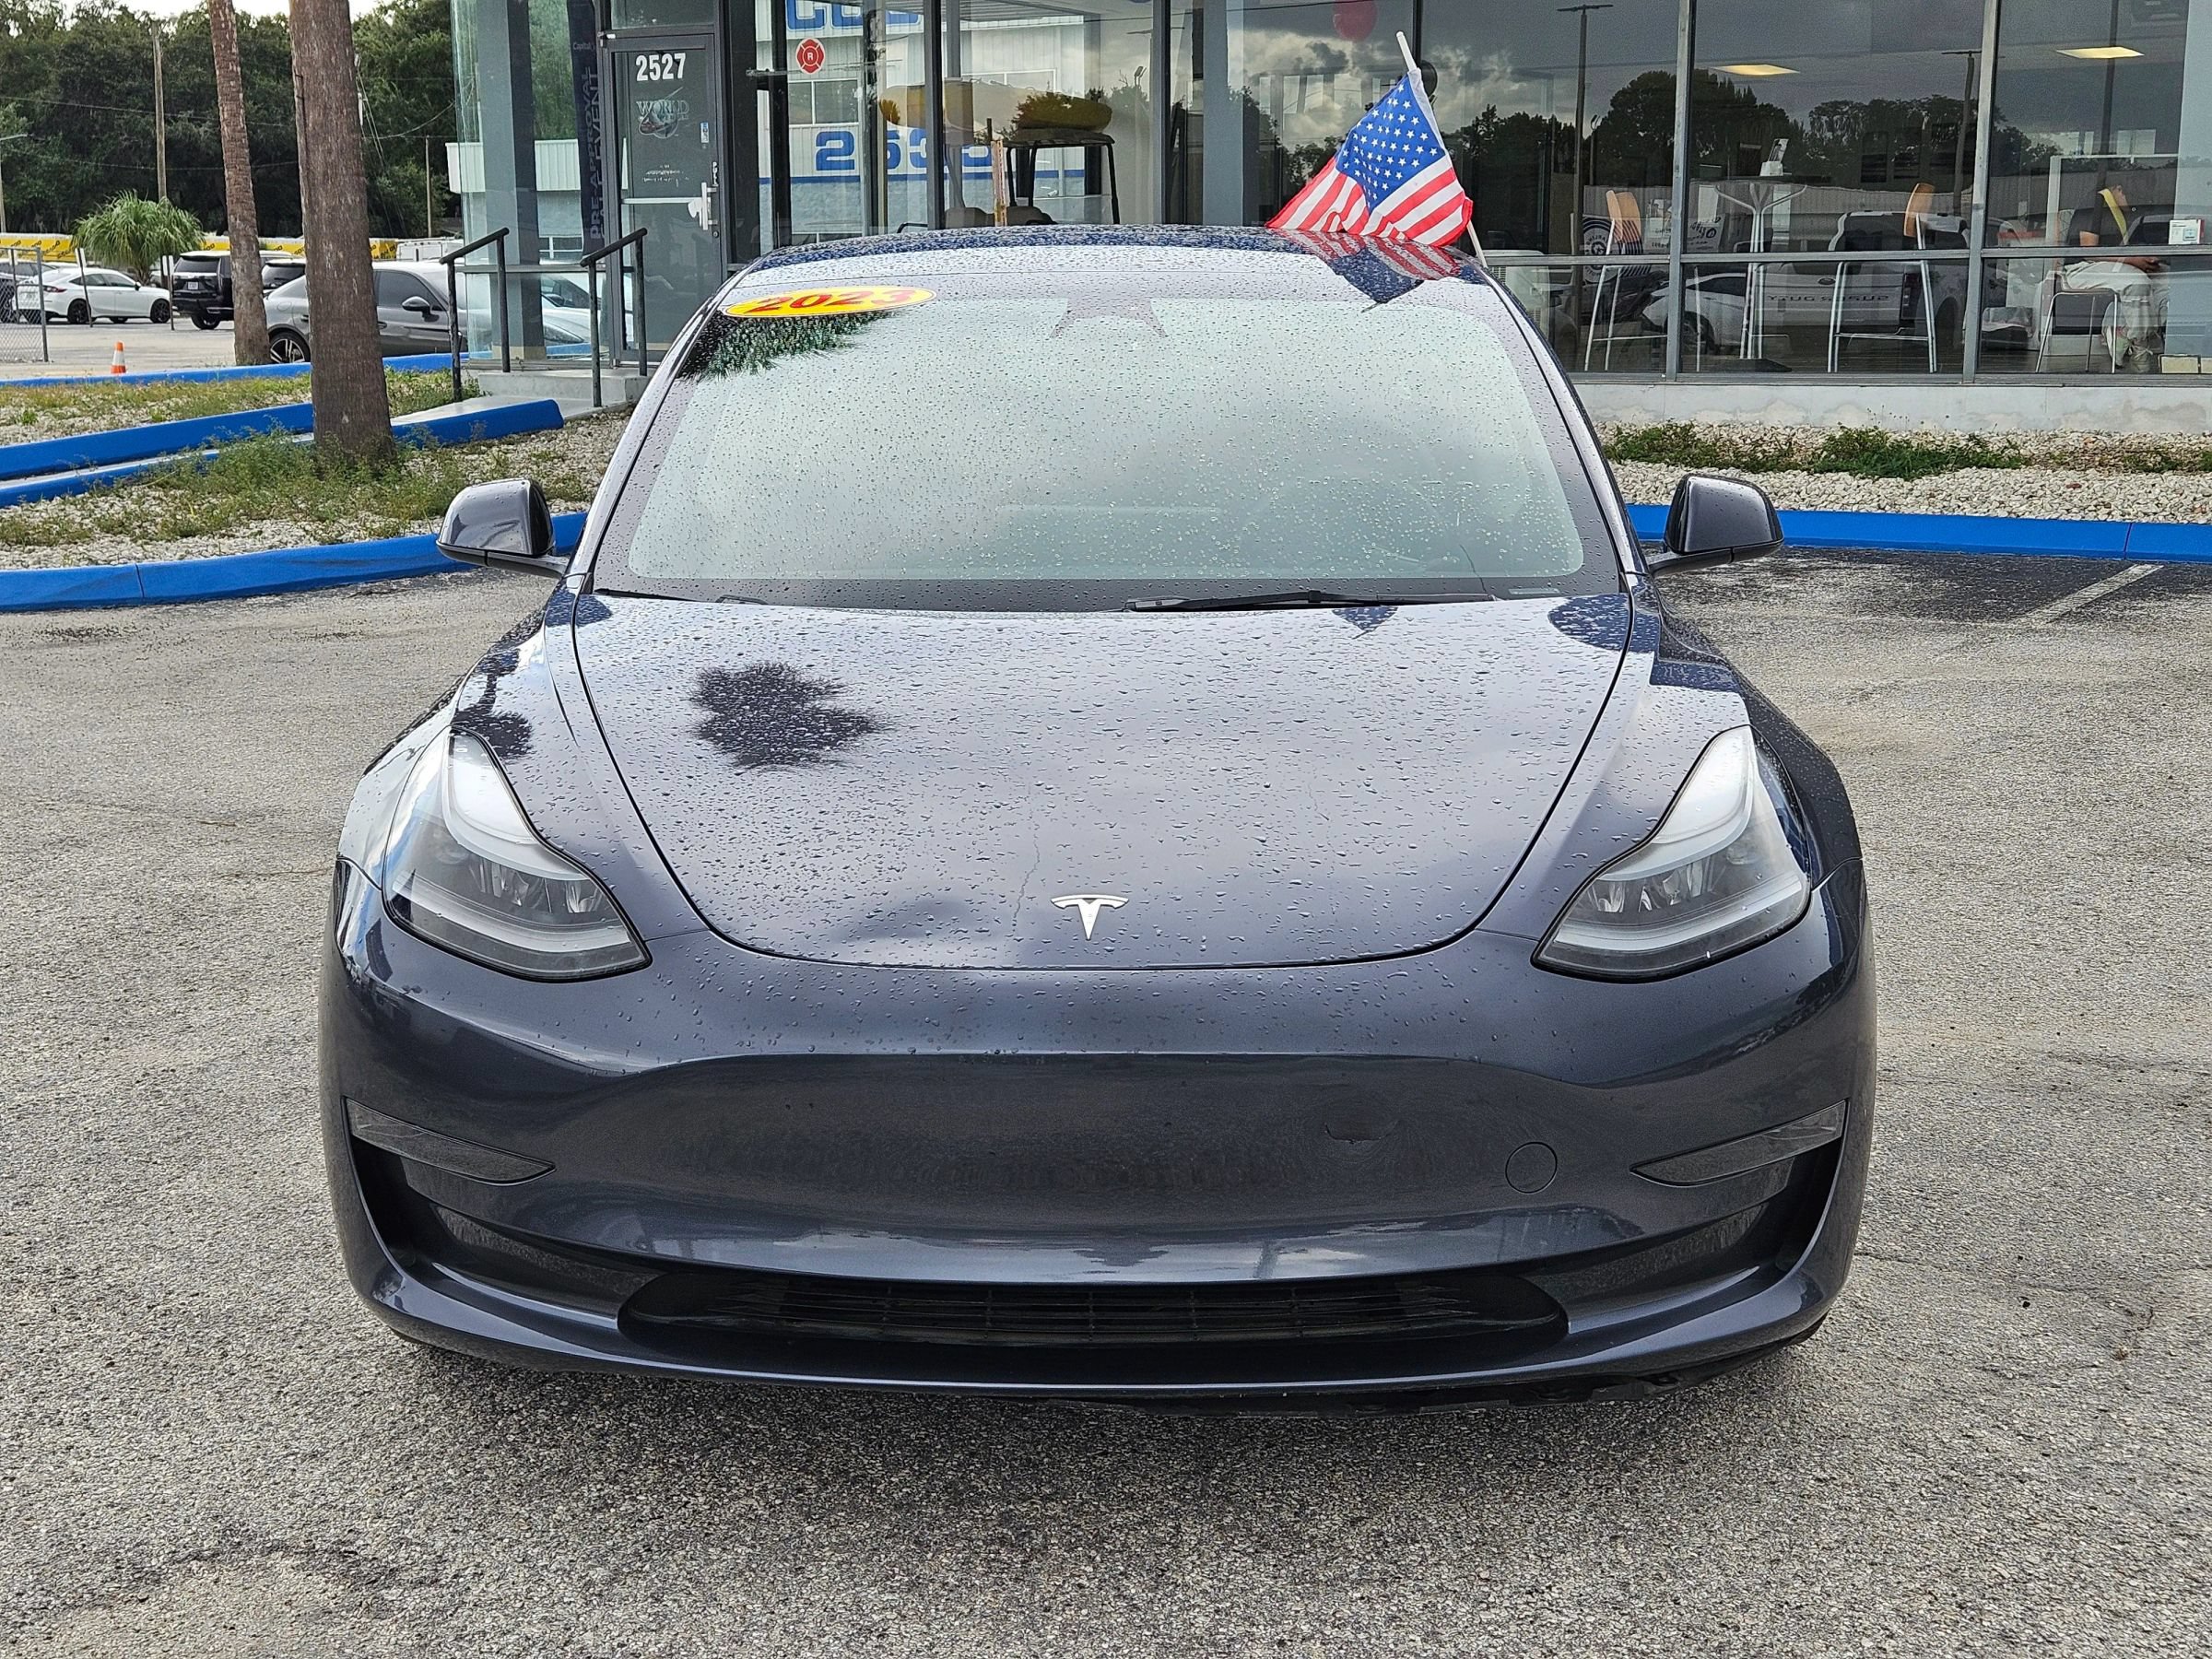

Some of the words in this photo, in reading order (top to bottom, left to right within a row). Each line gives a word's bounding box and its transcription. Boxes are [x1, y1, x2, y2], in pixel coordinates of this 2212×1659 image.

[636, 53, 686, 81] 2527
[806, 52, 814, 61] R
[743, 289, 917, 313] 2023
